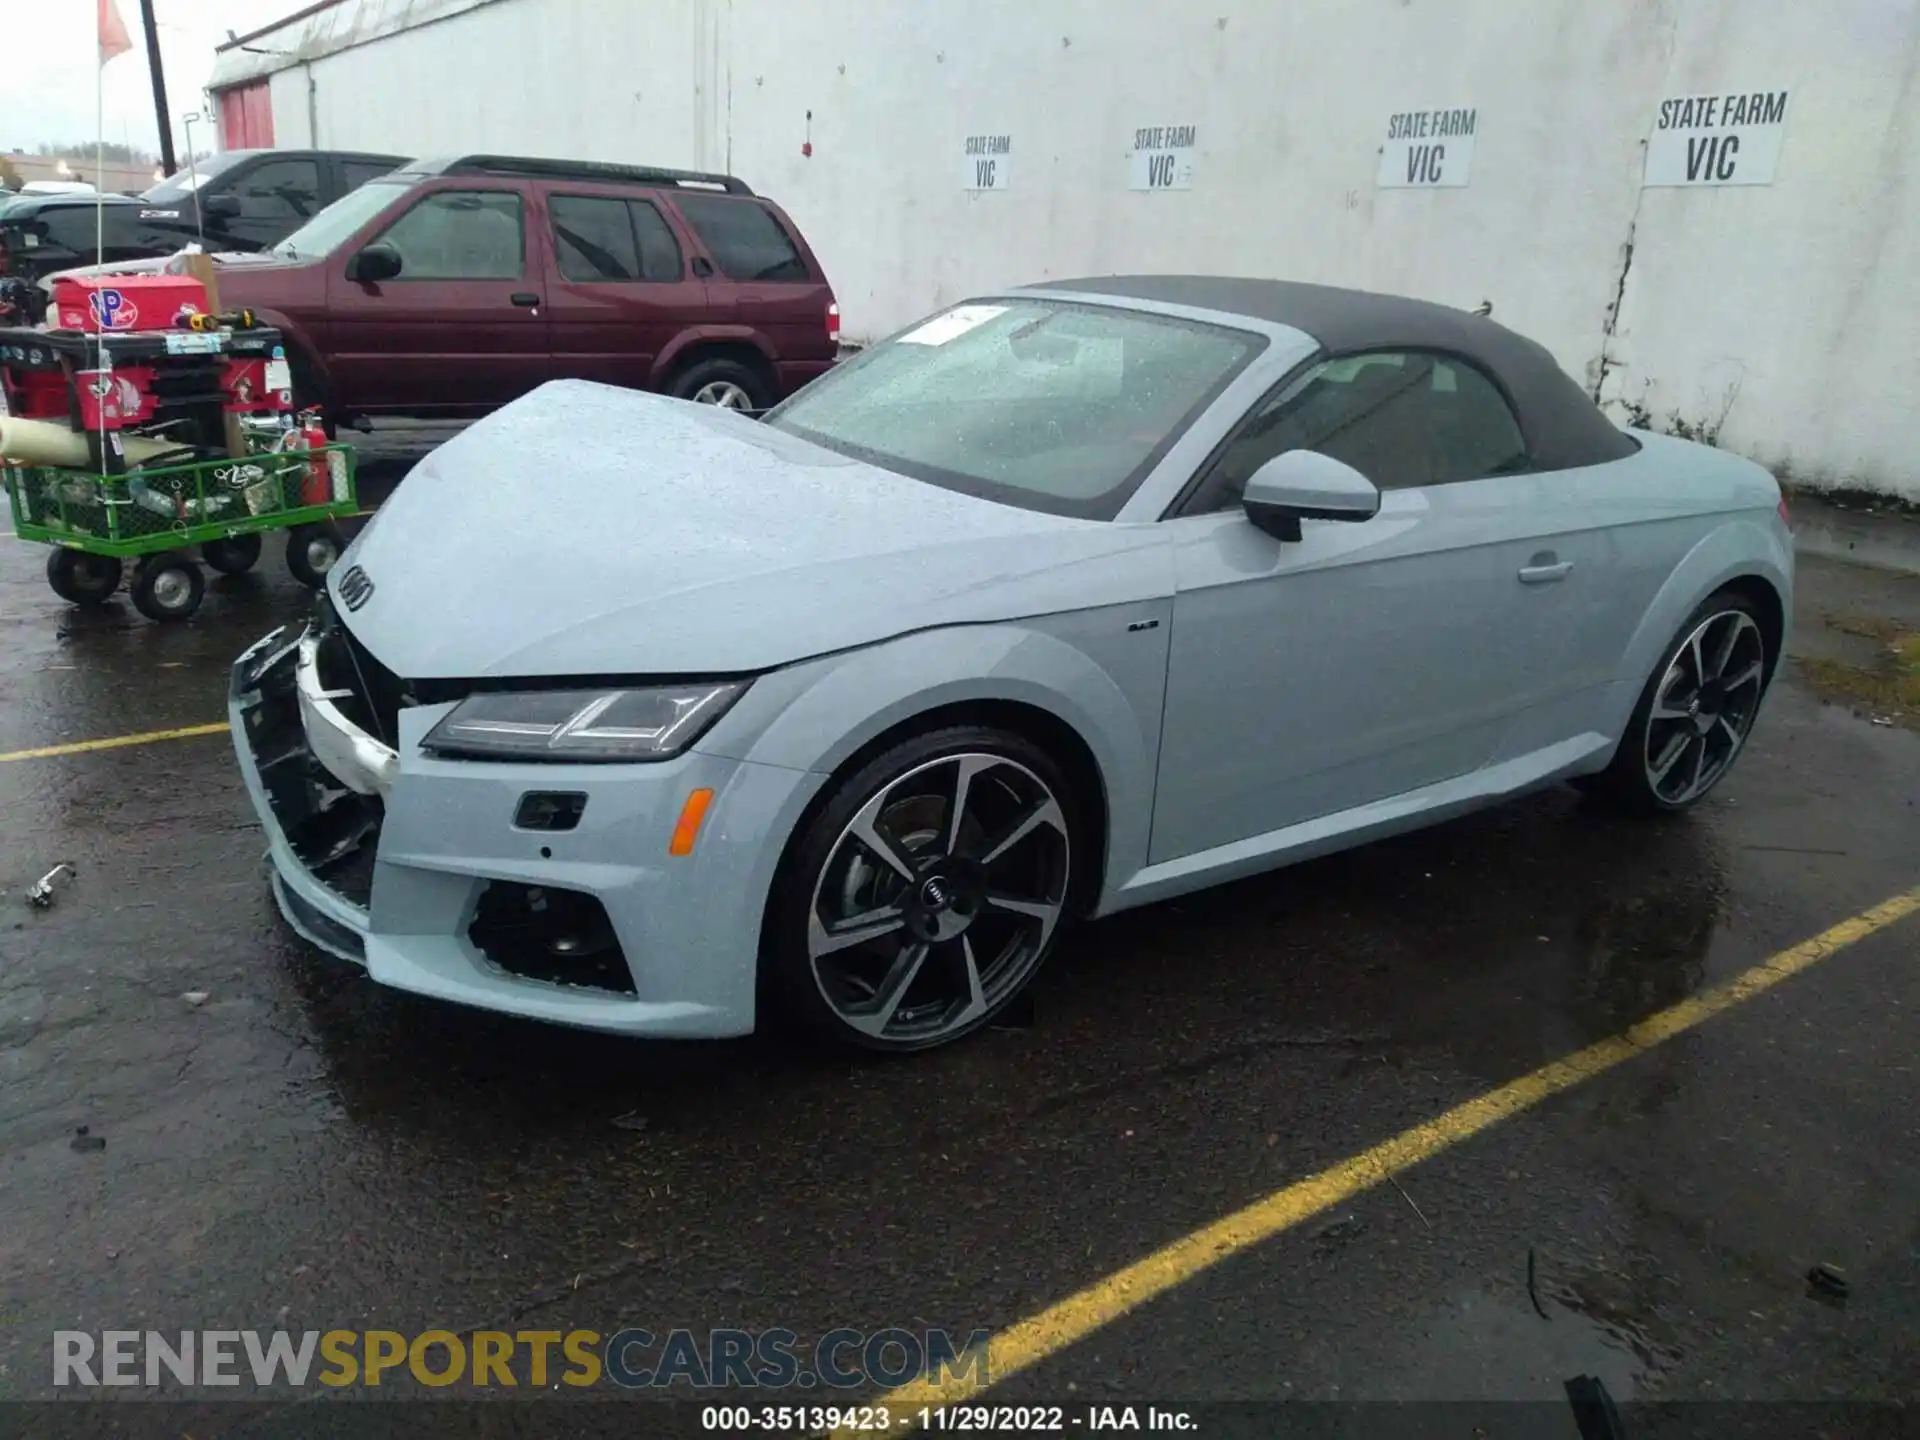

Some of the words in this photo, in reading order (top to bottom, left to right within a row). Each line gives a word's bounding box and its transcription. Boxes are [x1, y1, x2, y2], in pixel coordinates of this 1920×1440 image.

[1387, 112, 1430, 140] STATE
[1430, 108, 1477, 138] FARM
[1657, 96, 1719, 131] STATE
[1720, 90, 1789, 126] FARM
[965, 137, 987, 155] STATE
[1134, 128, 1164, 150] STATE
[1164, 126, 1196, 148] FARM
[976, 160, 996, 188] VIC
[1148, 155, 1175, 187] VIC
[1406, 144, 1446, 184] VIC
[1685, 136, 1740, 182] VIC
